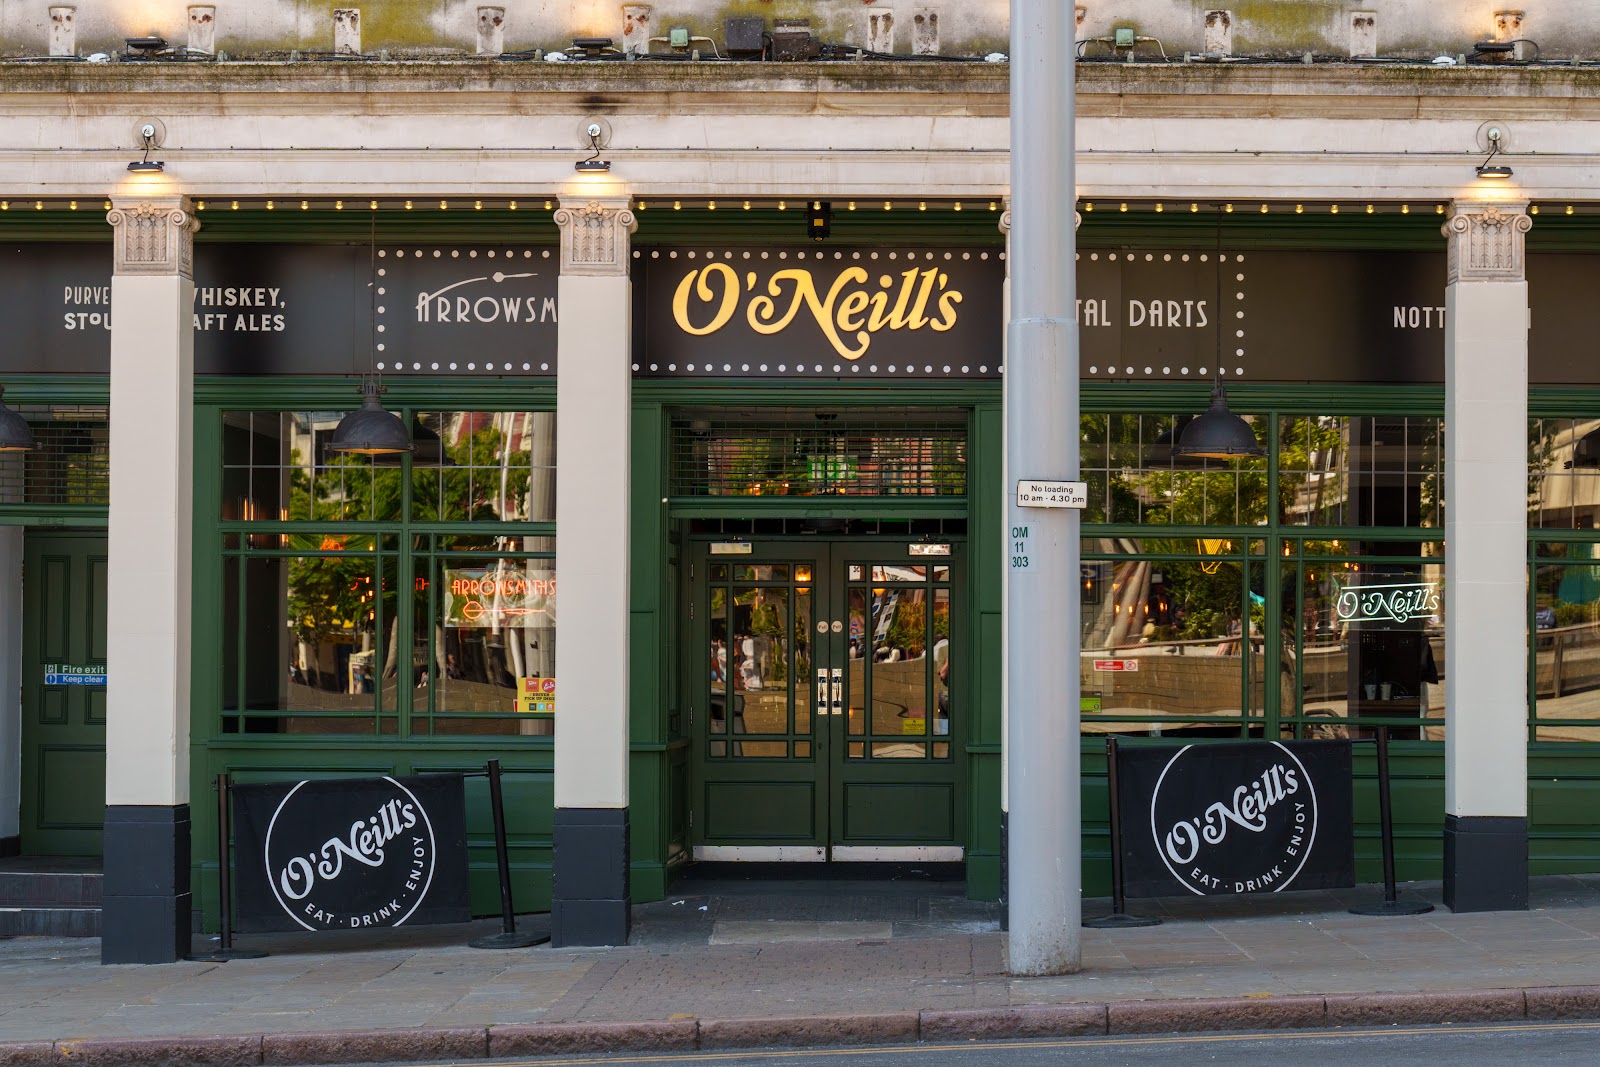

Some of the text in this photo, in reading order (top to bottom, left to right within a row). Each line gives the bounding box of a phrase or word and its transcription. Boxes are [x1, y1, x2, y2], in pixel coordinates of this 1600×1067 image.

[64, 286, 110, 305] PURVE
[415, 291, 557, 323] ARROWSM
[671, 262, 963, 361] O'Neill's
[1075, 299, 1208, 327] TAL DARTS
[1393, 306, 1446, 329] NOTT
[64, 312, 286, 332] STOU AFT ALES
[1031, 485, 1074, 494] No loading
[1012, 527, 1028, 538] OM
[1014, 542, 1024, 553] 11
[1012, 556, 1029, 567] 303
[451, 579, 556, 596] ARROWSMITHS
[1337, 589, 1440, 623] O'Neill's
[62, 665, 105, 674] Fire exit
[62, 675, 104, 684] Keep clear
[1165, 764, 1299, 864] O'Neill's
[280, 798, 417, 900] O'Neill's
[1190, 801, 1305, 893] EAT DRINK ENJOY
[304, 836, 424, 928] EAT DRINK ENJOY
